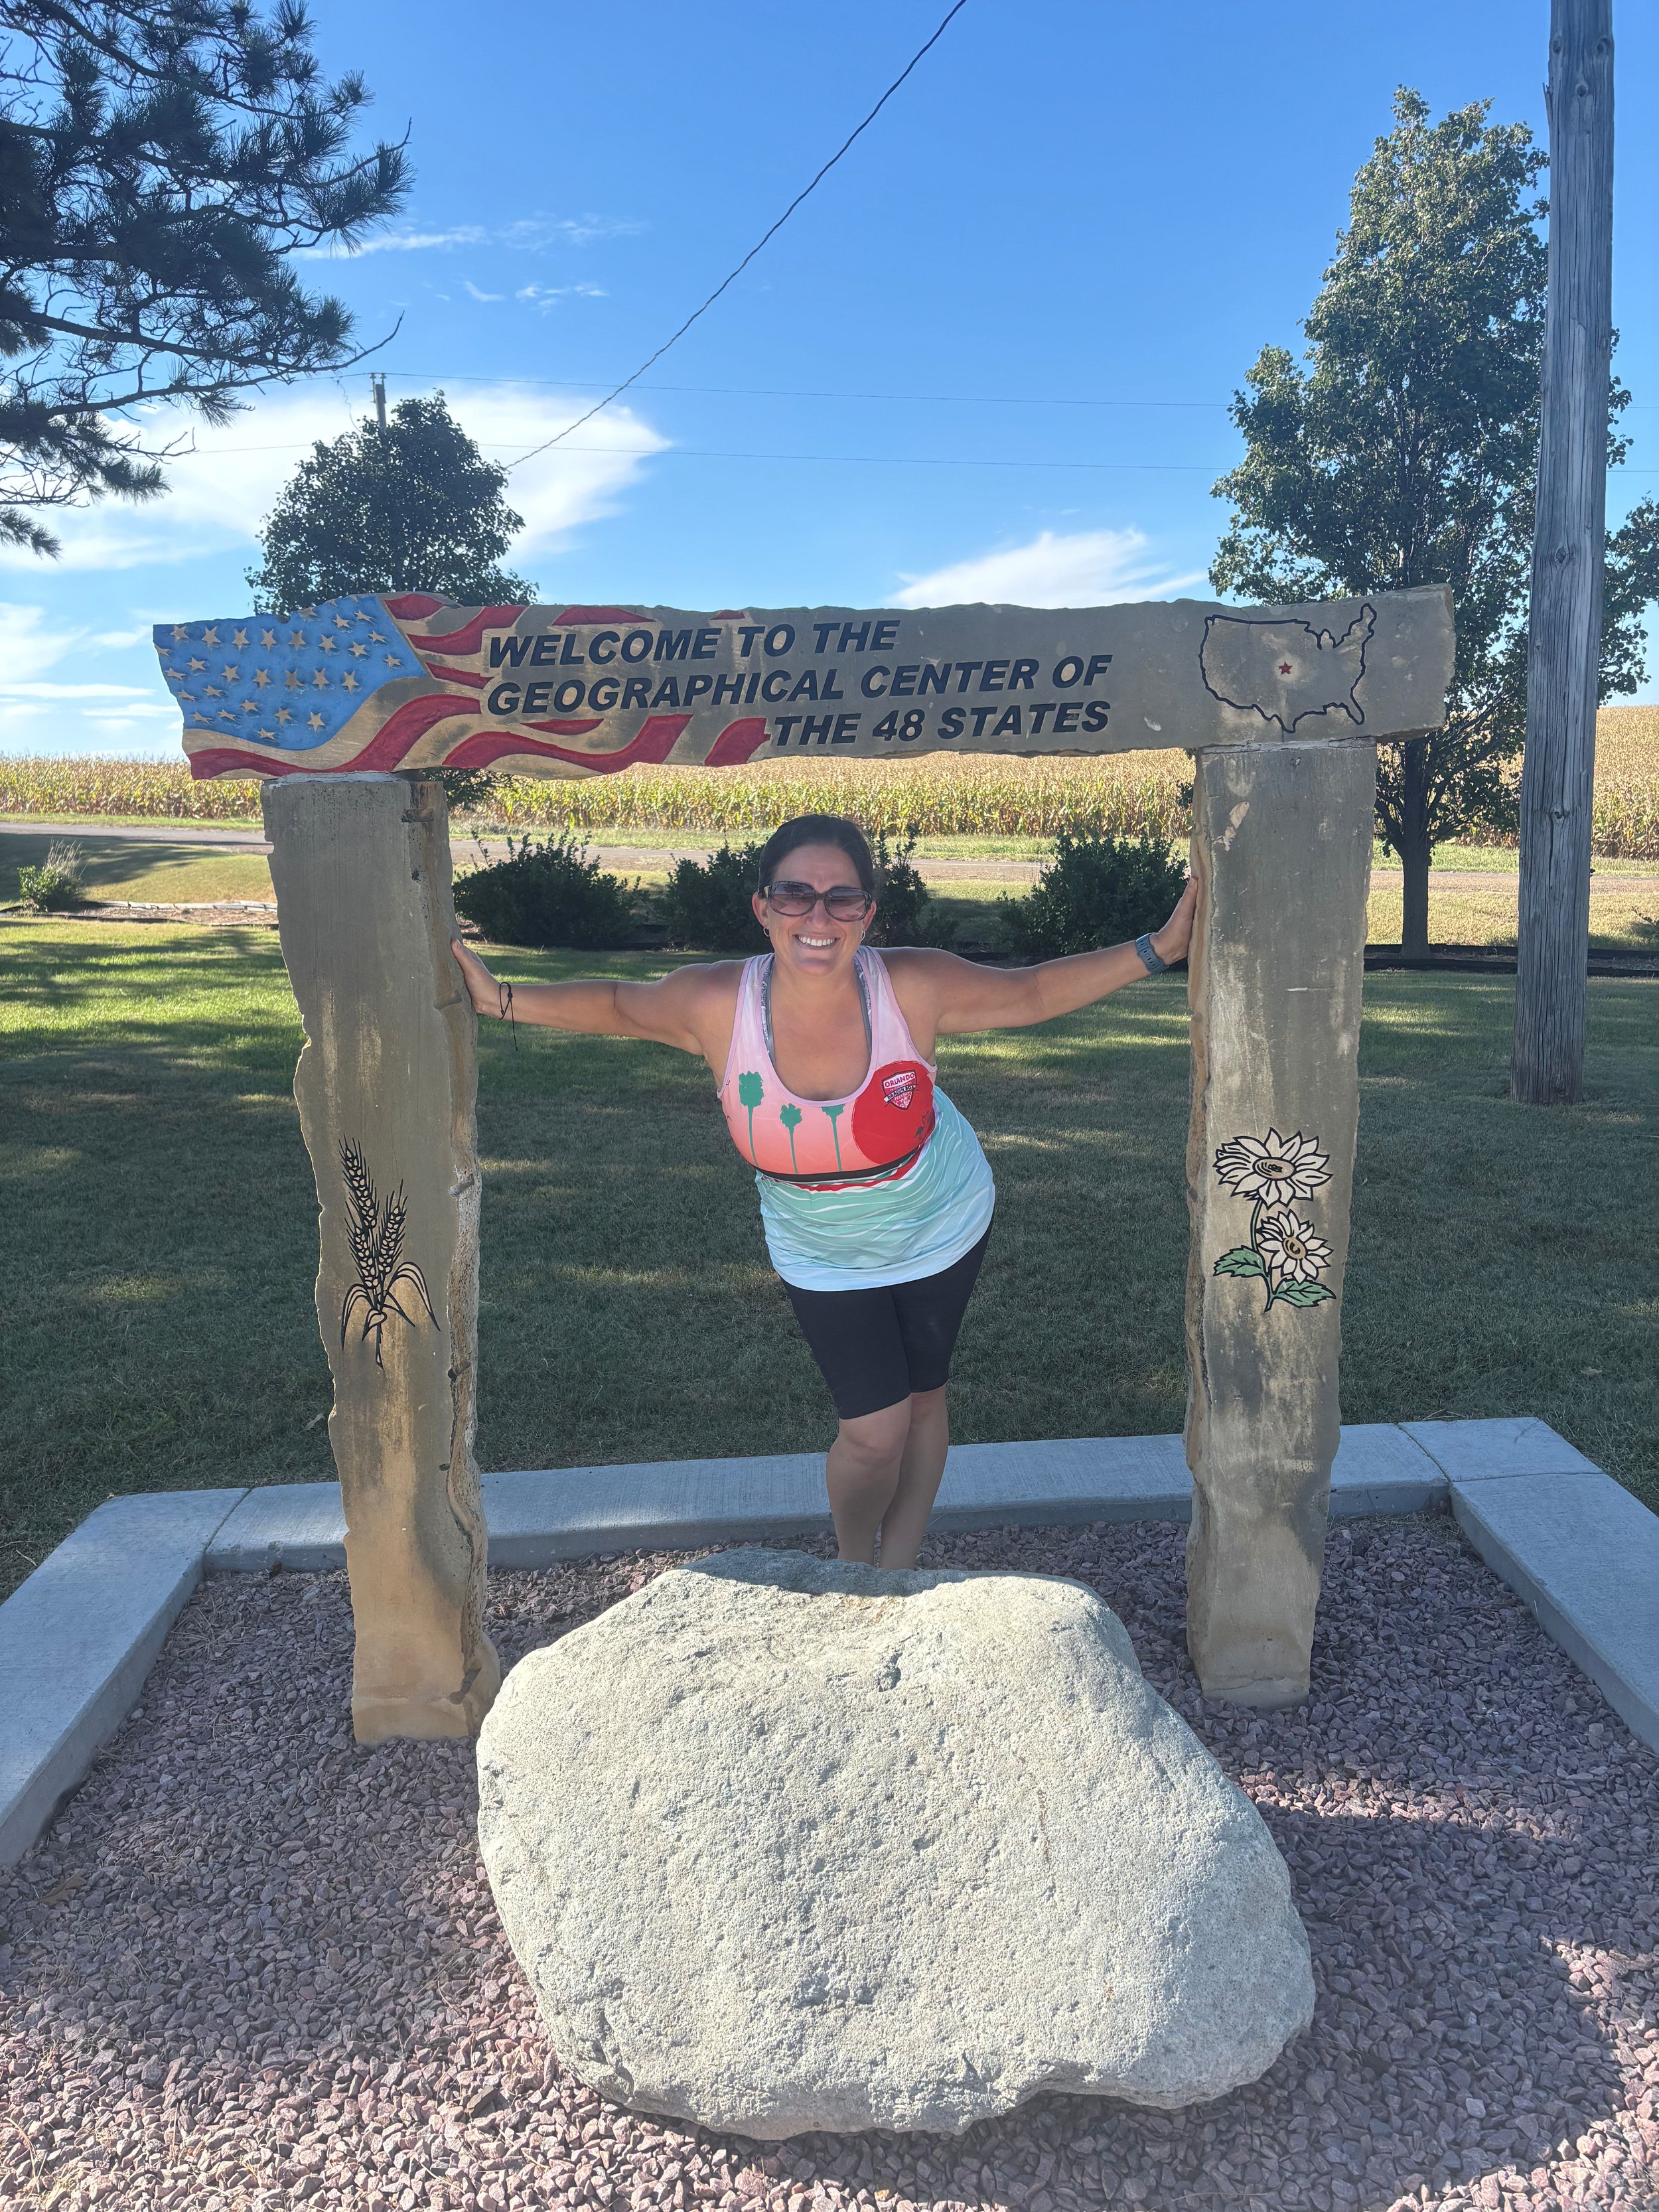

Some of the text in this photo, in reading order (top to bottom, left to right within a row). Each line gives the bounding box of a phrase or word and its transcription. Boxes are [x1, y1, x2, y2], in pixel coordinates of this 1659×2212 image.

[488, 620, 901, 668] WELCOME TO THE
[487, 654, 1114, 715] GEOGRAPHICAL CENTER OF
[774, 700, 1111, 747] THE 48 STATES
[885, 1072, 914, 1087] ORLANDO
[887, 1088, 904, 1100] DRAGON
